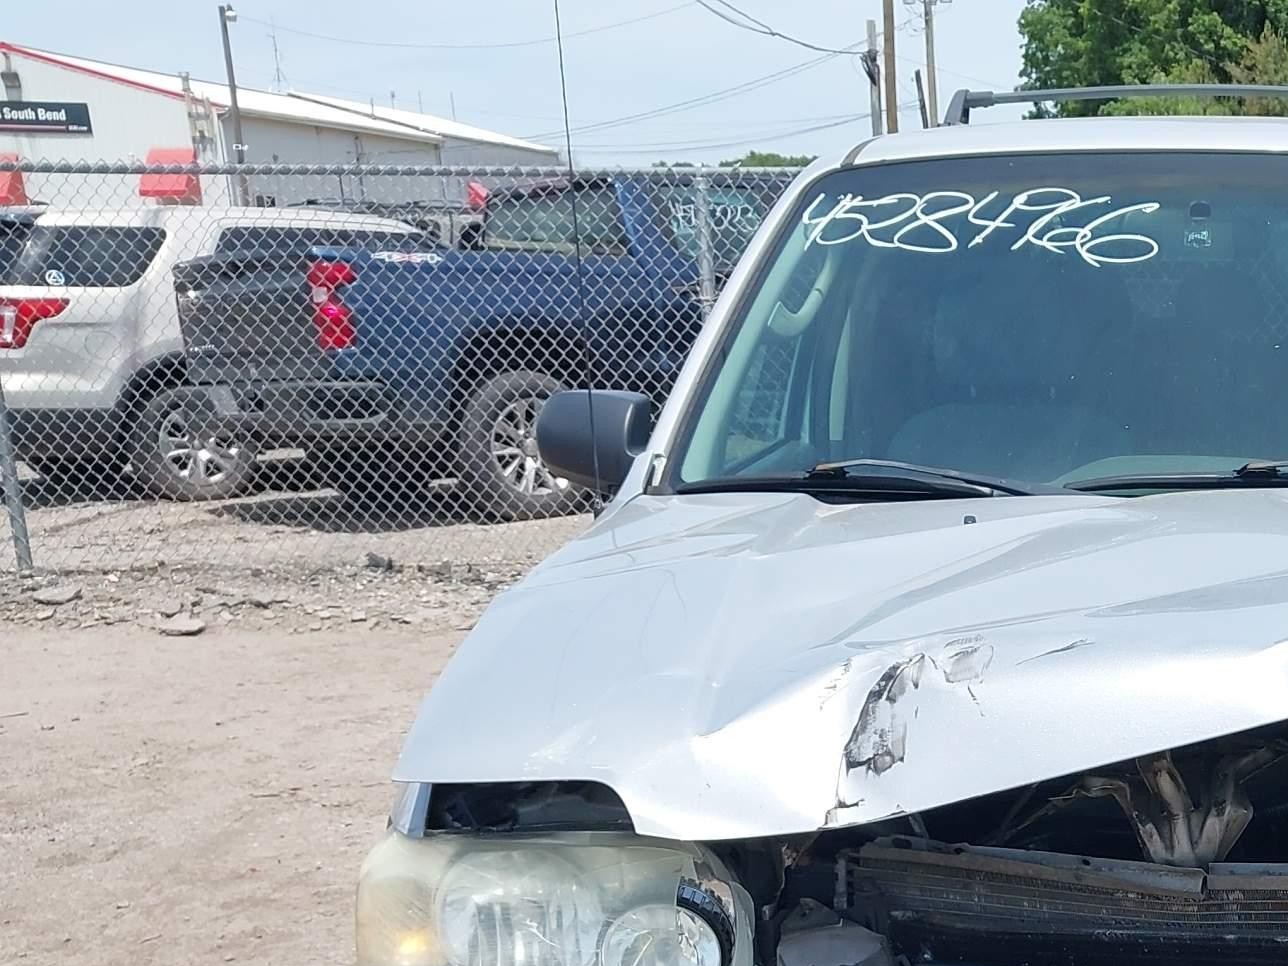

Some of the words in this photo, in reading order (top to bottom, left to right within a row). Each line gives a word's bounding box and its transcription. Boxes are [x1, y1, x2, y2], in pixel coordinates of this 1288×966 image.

[3, 106, 36, 120] South
[37, 108, 67, 121] Bend
[802, 187, 1161, 267] 45284966
